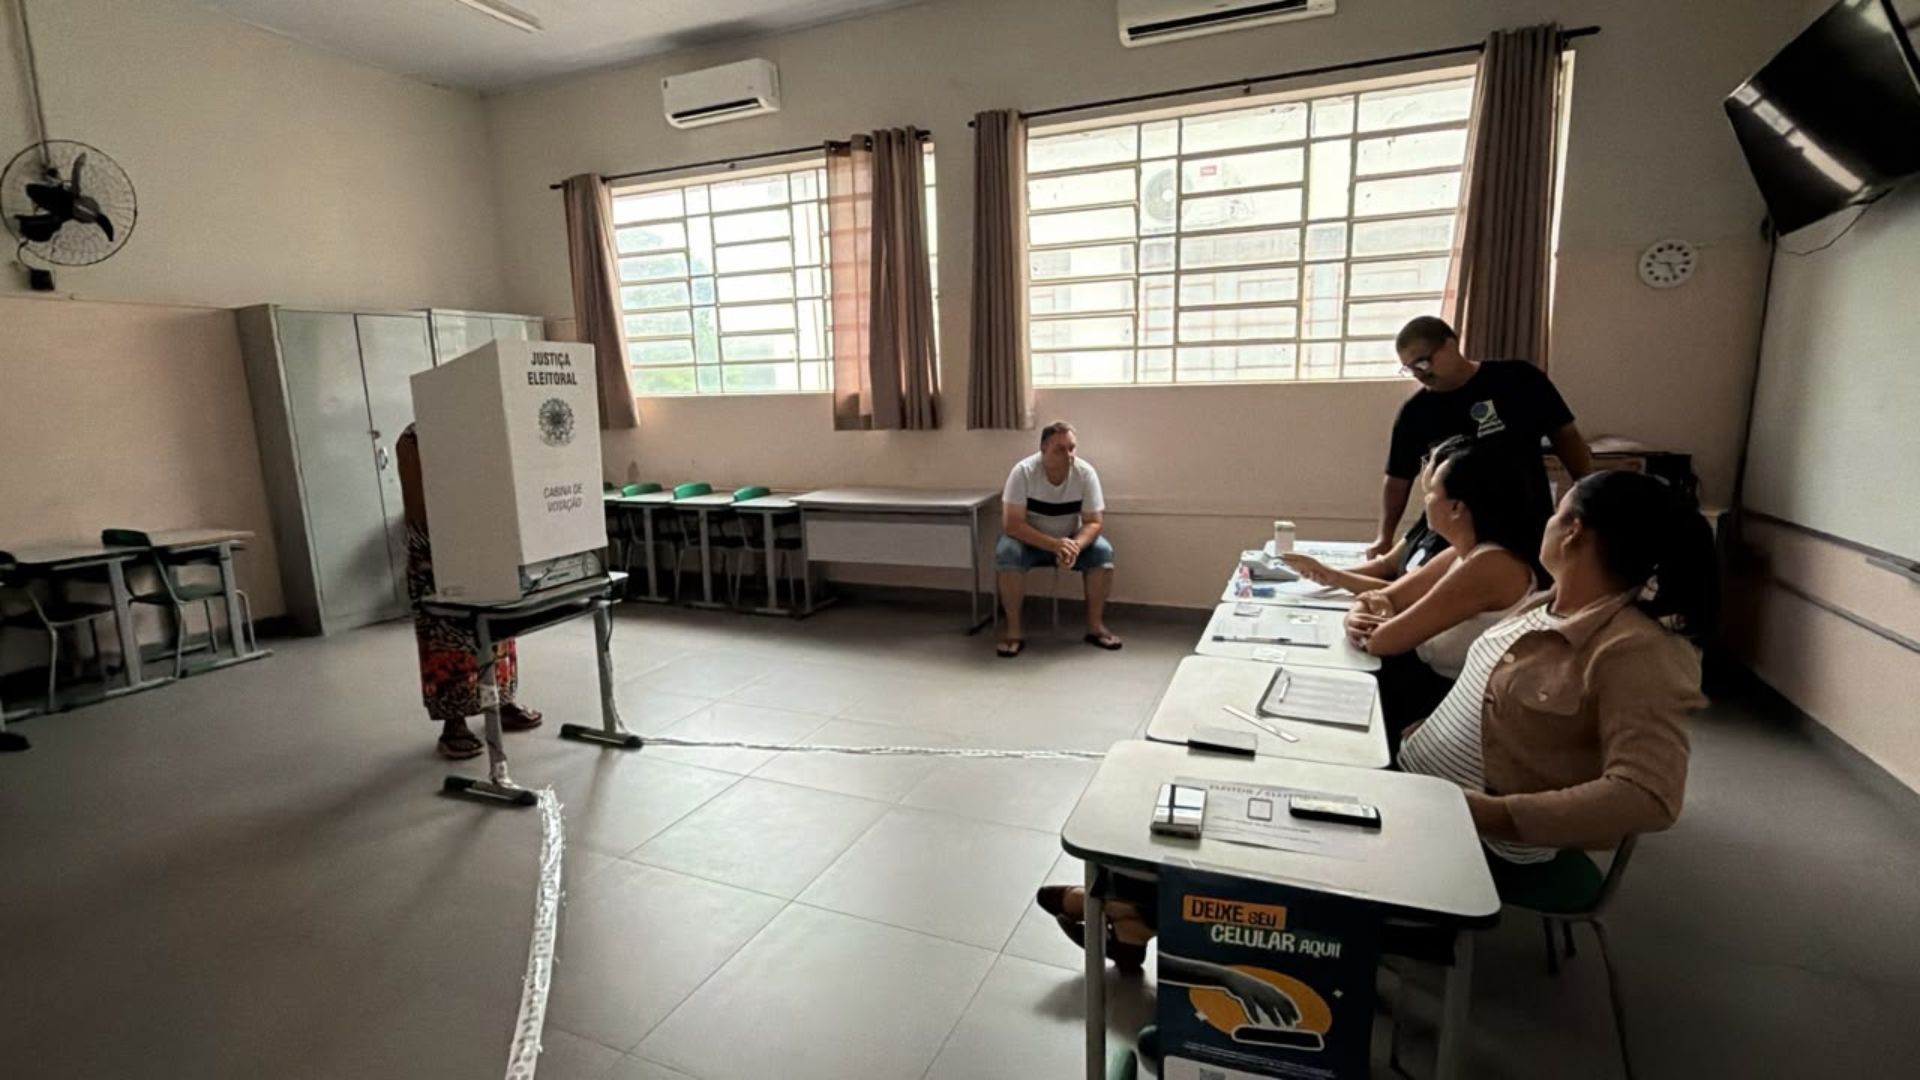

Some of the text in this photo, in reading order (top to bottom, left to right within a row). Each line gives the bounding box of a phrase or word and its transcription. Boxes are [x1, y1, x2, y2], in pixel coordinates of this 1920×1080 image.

[531, 351, 571, 369] JUSTIÇA
[527, 371, 578, 386] ELEITORAL
[543, 482, 583, 499] CABINA DE
[547, 496, 582, 512] VOTAÇÃO
[1191, 899, 1276, 927] DEIXE SEU
[1210, 923, 1295, 953] CELULAR
